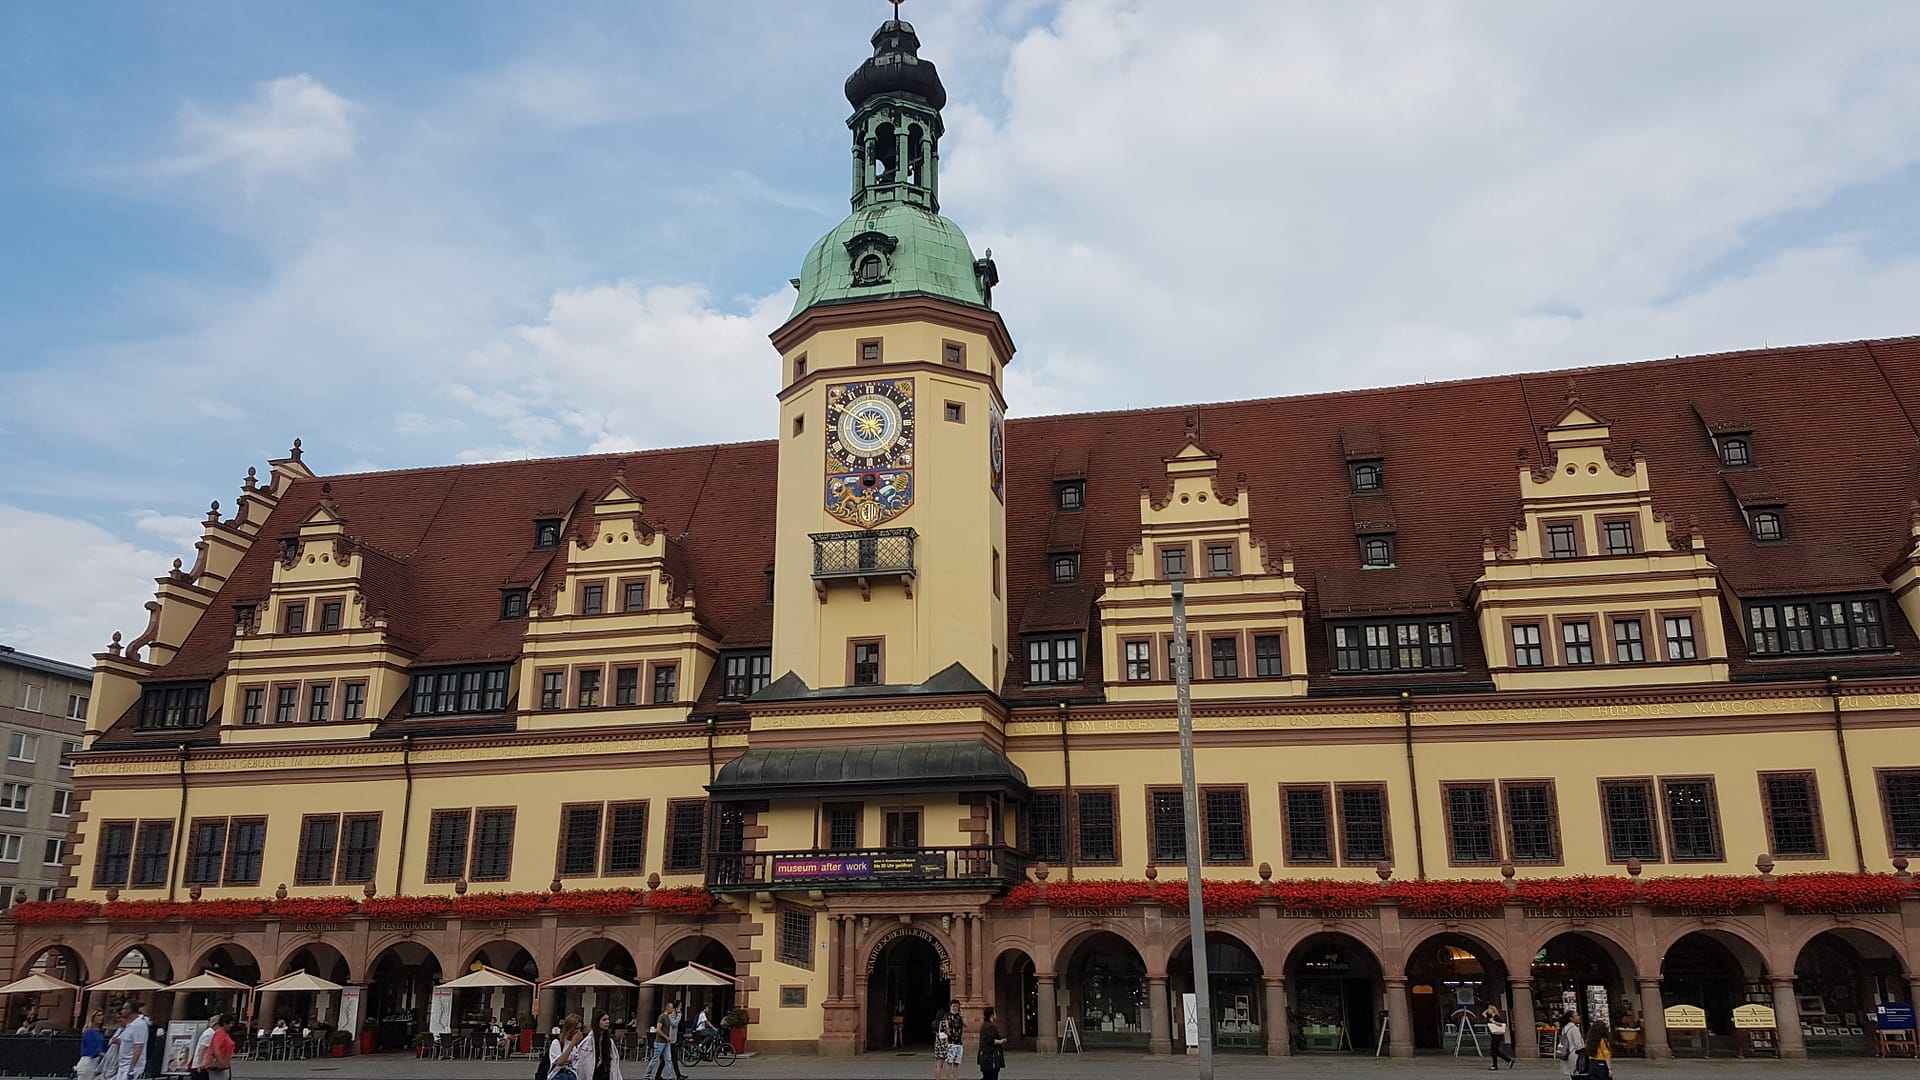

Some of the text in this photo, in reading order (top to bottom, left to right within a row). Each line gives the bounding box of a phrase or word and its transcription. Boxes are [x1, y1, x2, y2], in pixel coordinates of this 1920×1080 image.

[1870, 695, 1920, 707] MEISS
[1104, 719, 1155, 731] REICHS
[1175, 615, 1195, 824] STADTGESCHICHTLICHES
[1288, 716, 1323, 727] UND
[239, 757, 285, 770] GEBURTH
[778, 861, 867, 873] museum after work
[1066, 907, 1128, 918] MEISSENER
[1283, 907, 1375, 918] EDLE TROPFEN
[1412, 908, 1492, 918] AUGENOPTIK
[1526, 907, 1548, 918] TEE
[1552, 909, 1562, 918] &
[296, 922, 337, 931] BRASSERIE
[380, 920, 436, 930] RESTAURANT
[867, 928, 933, 975] STADTGESCHICHTLICHES
